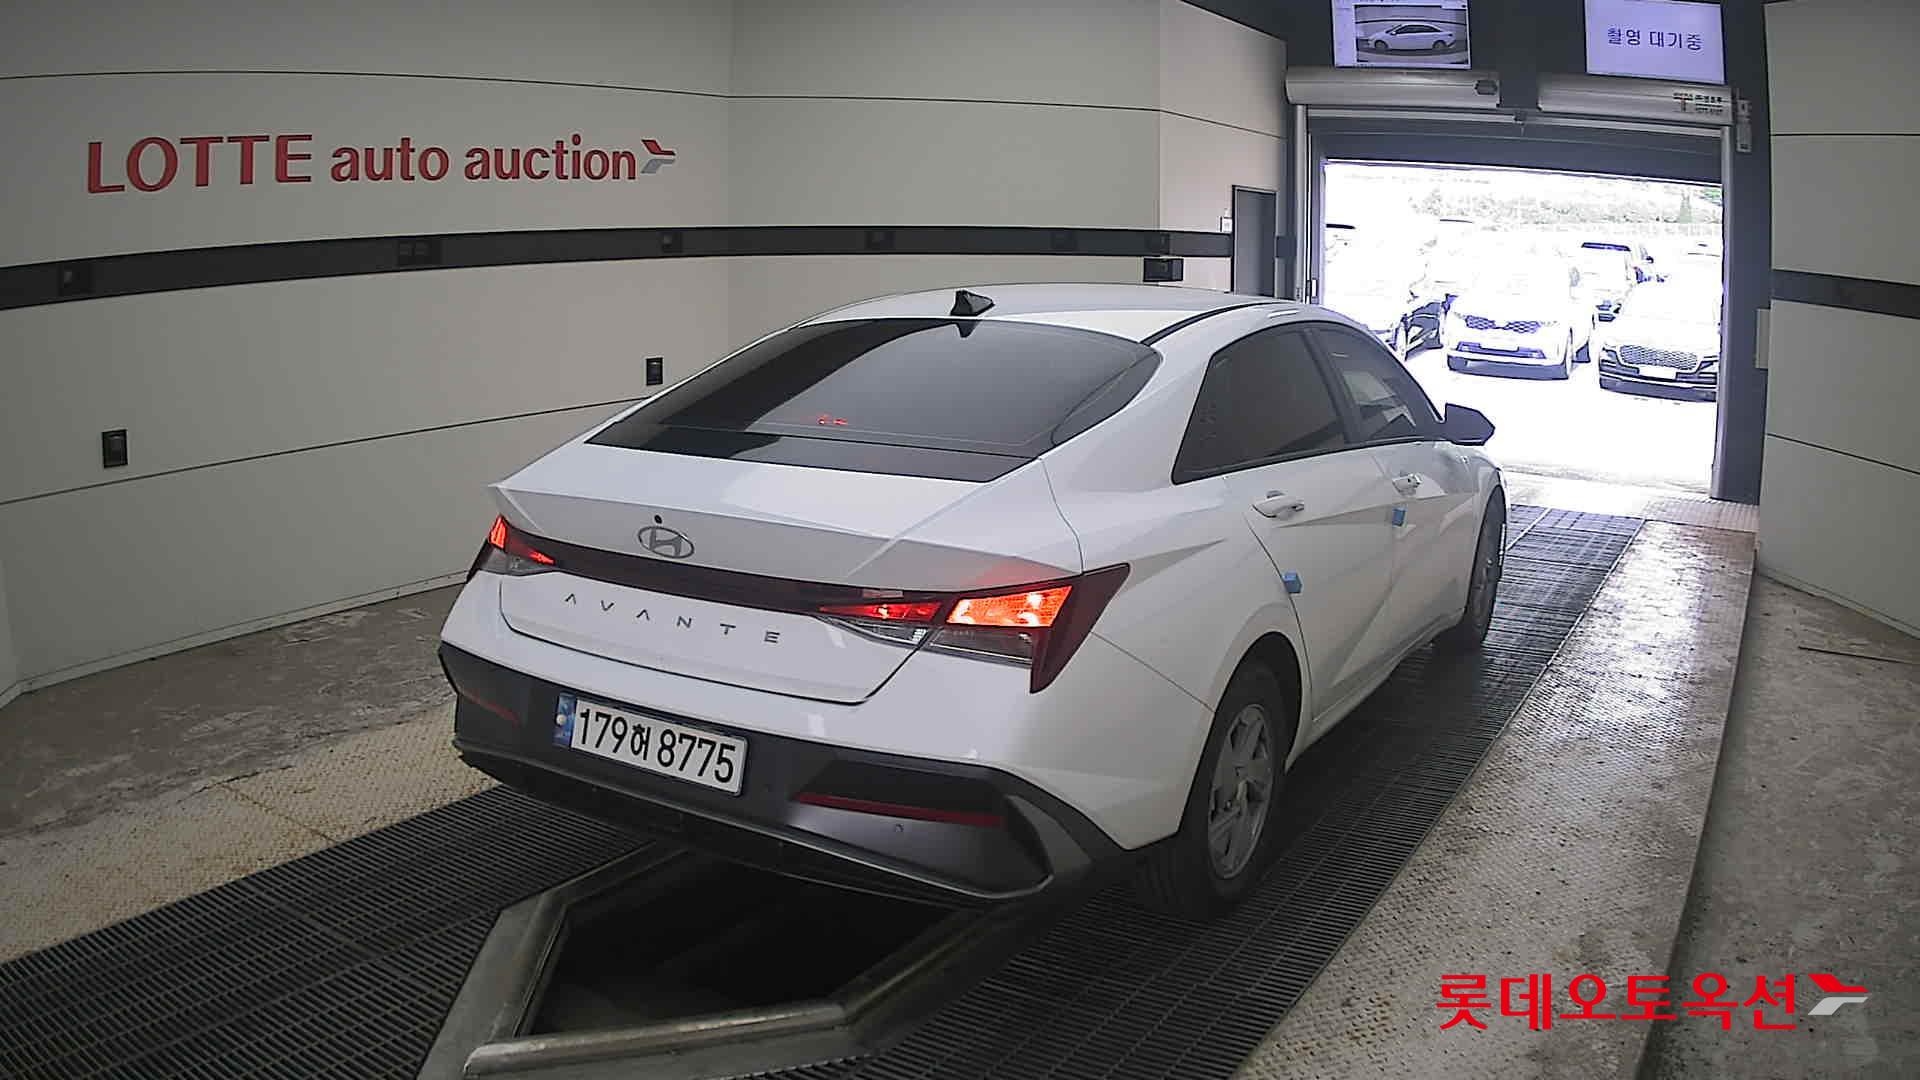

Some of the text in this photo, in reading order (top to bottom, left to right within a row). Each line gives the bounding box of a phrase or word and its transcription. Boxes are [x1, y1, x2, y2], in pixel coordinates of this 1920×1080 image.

[1649, 31, 1702, 51] 대기중
[87, 133, 637, 193] LOTTE auto auction
[564, 593, 781, 644] AVANTE
